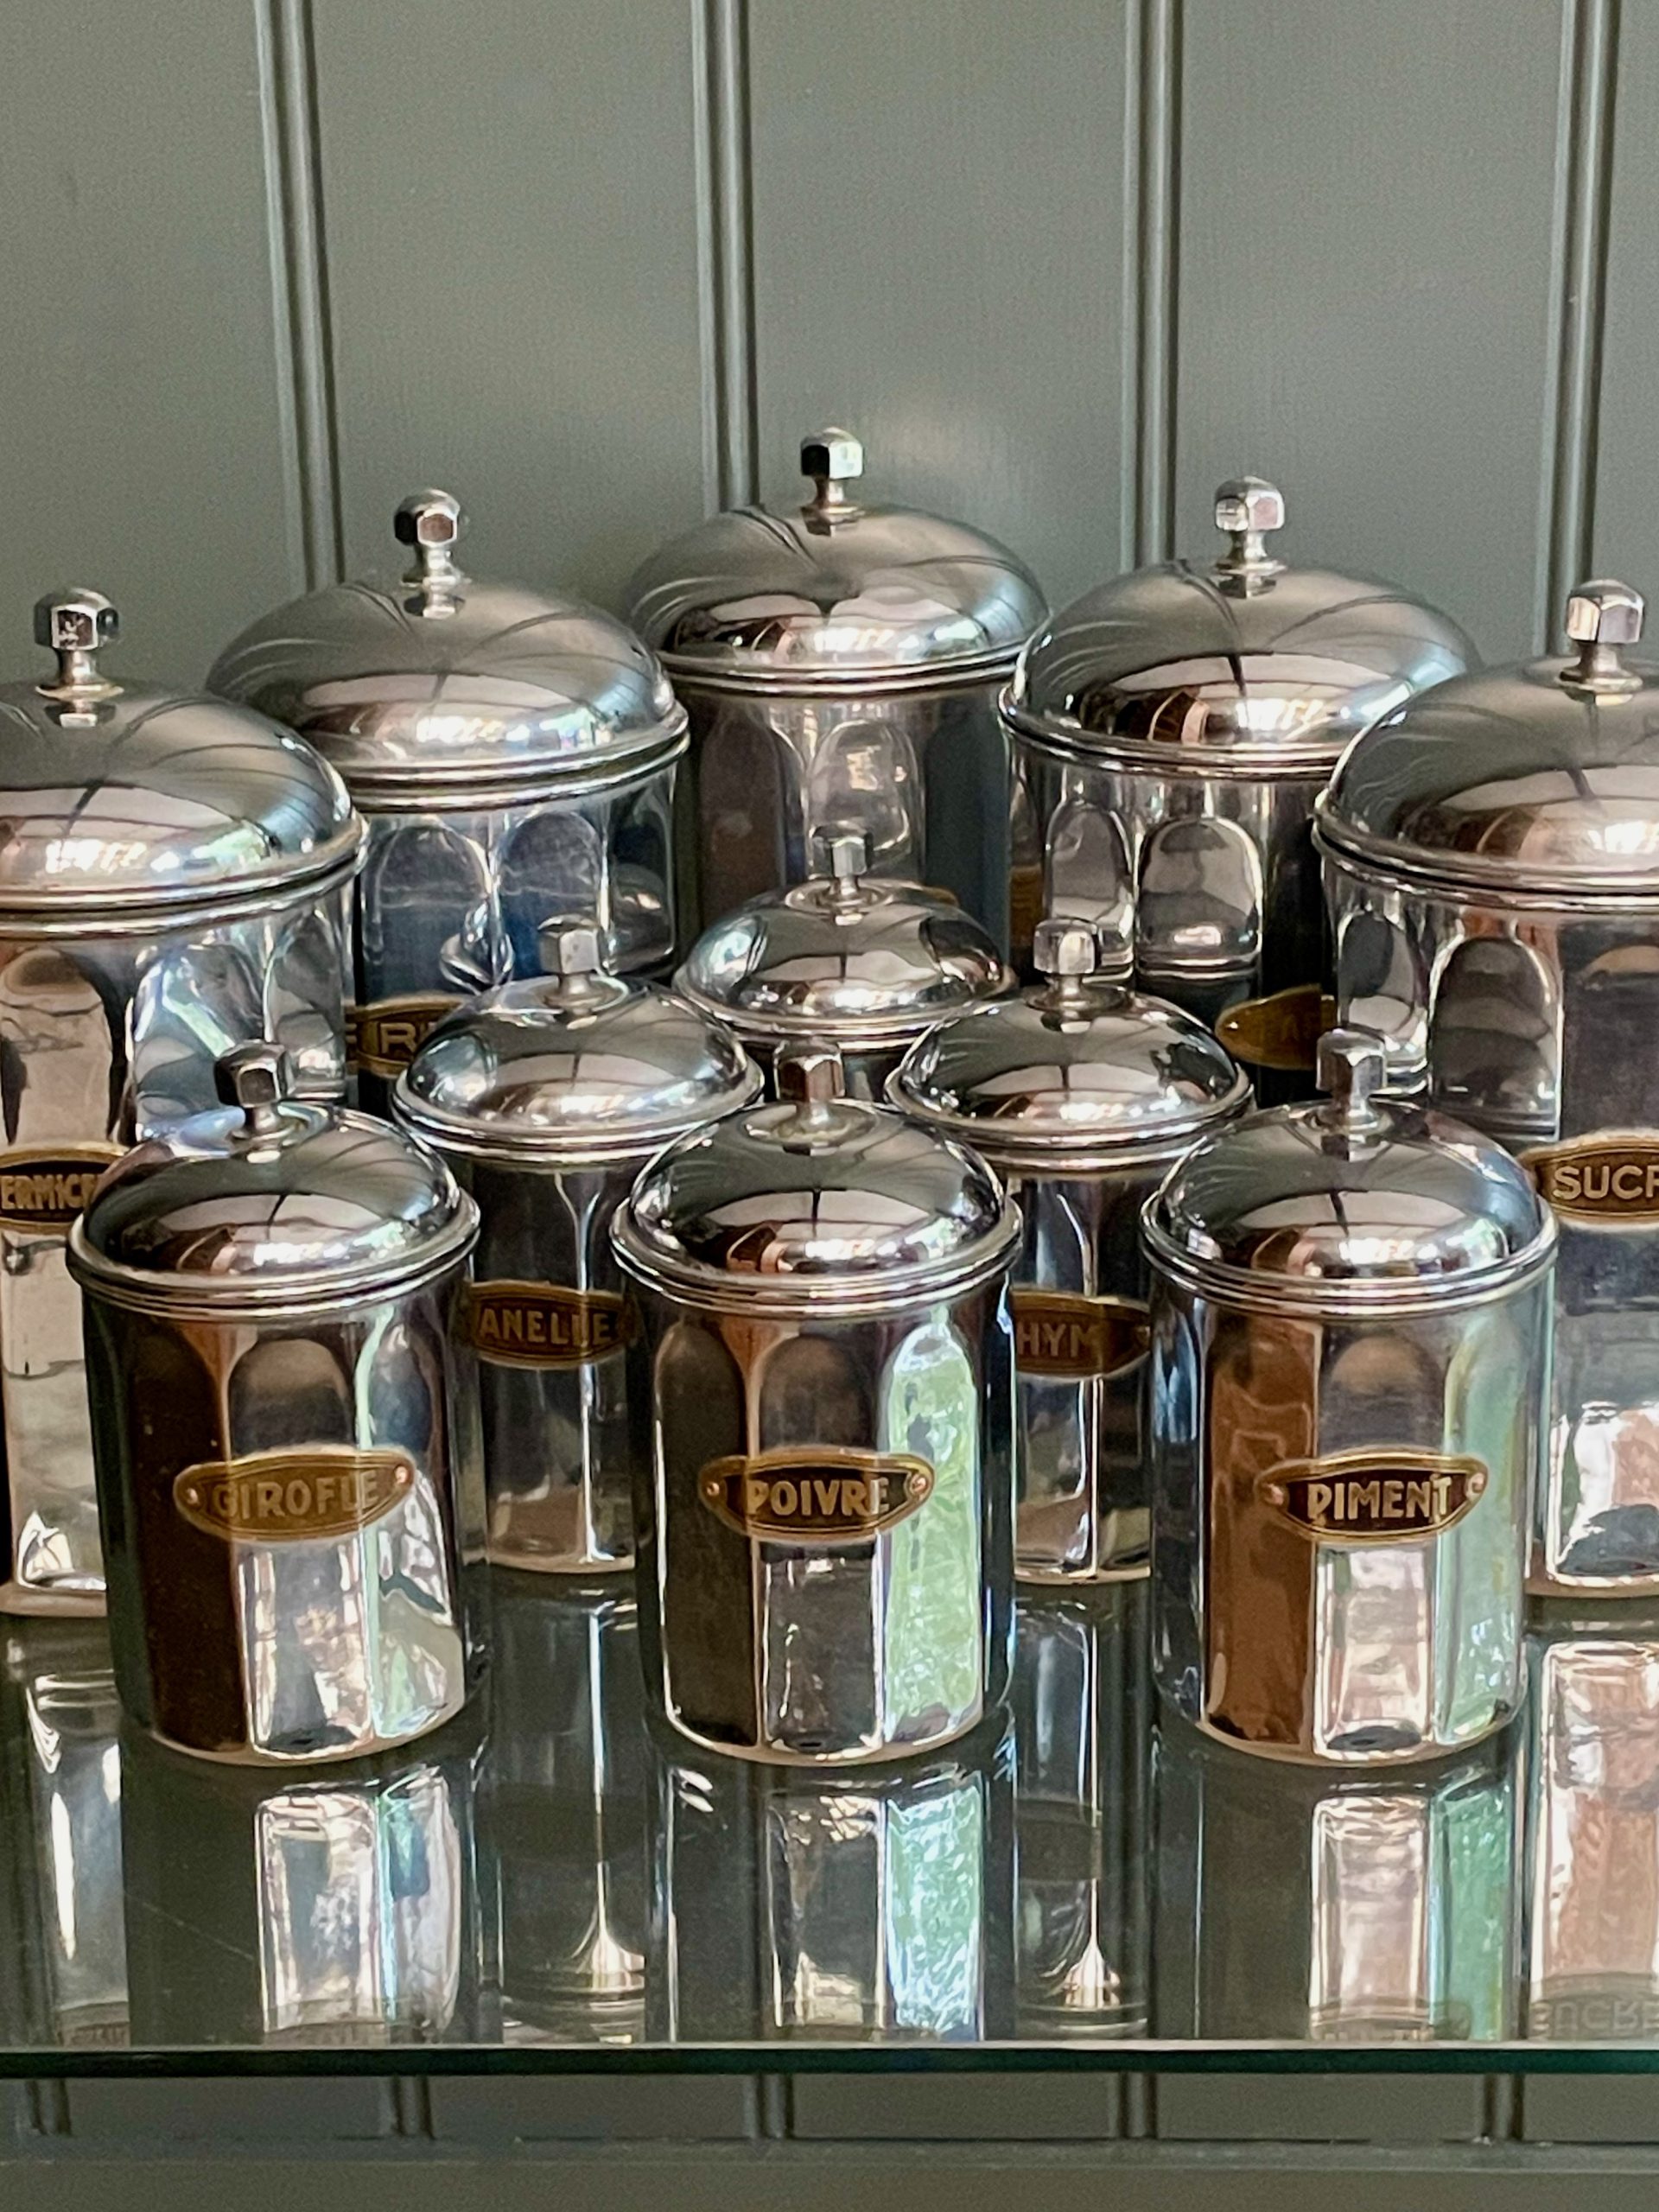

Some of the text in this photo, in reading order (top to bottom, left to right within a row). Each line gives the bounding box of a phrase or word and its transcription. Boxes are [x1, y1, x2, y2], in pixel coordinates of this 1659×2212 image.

[213, 1470, 379, 1519] GIROFLE
[747, 1477, 890, 1516] POIVRE
[1307, 1477, 1452, 1520] PIMENT
